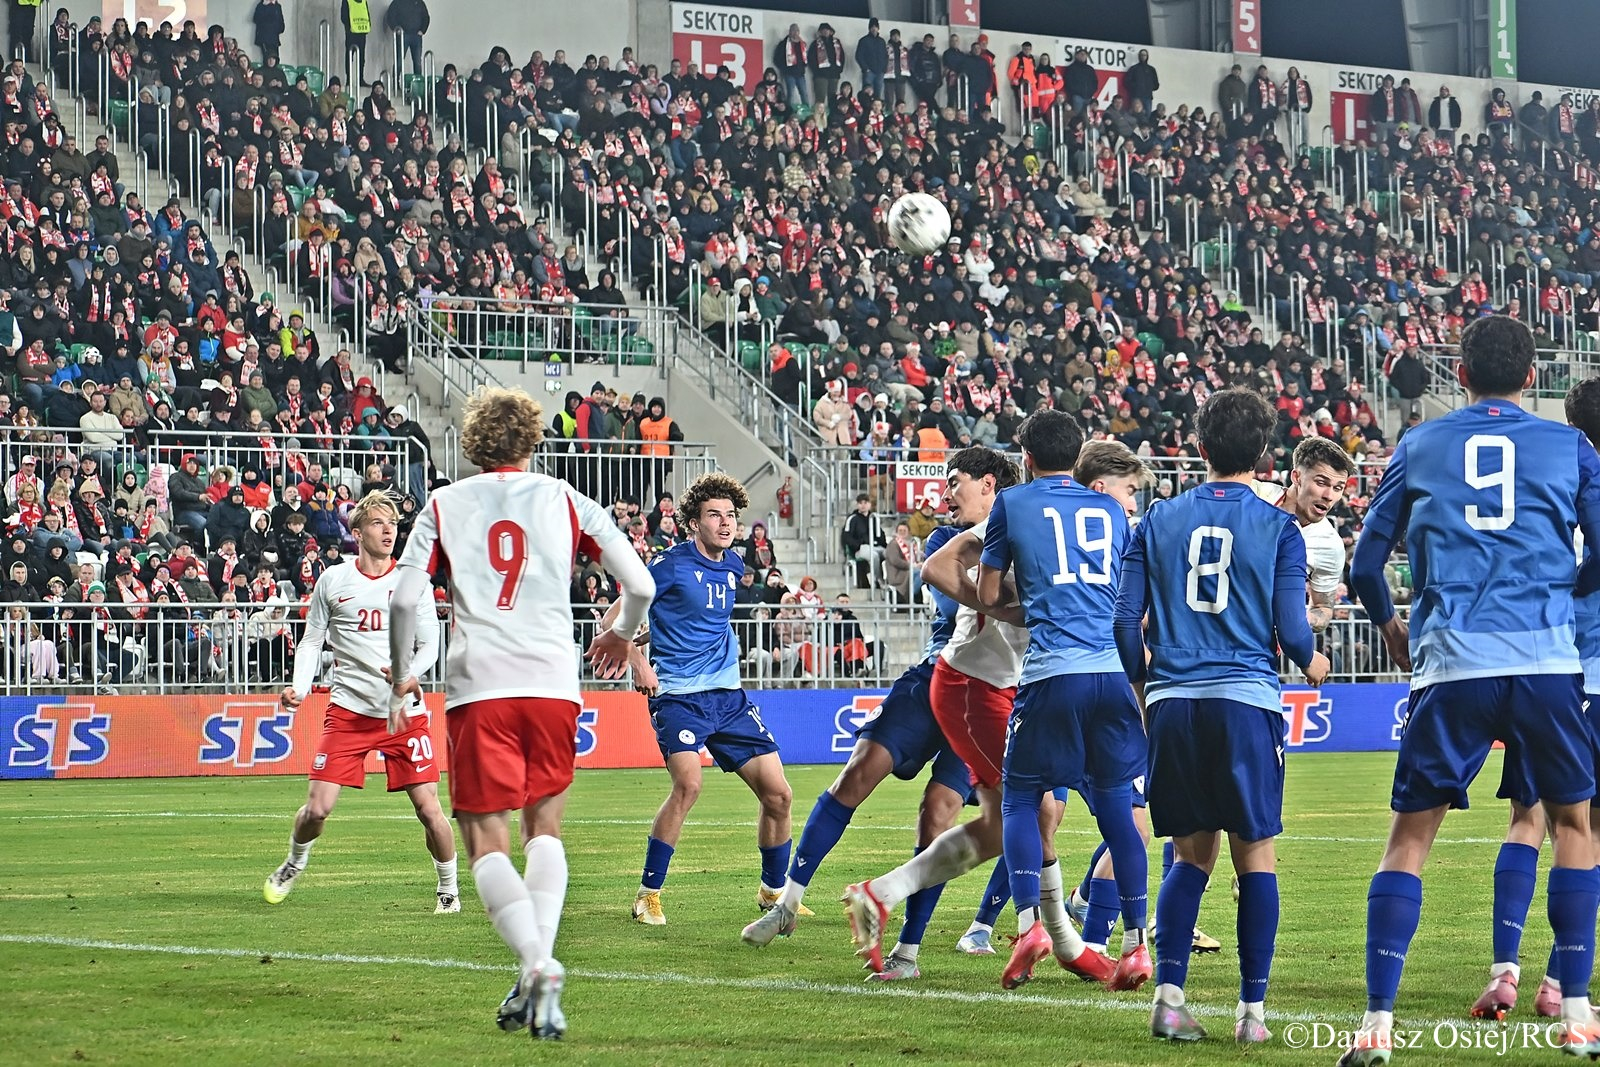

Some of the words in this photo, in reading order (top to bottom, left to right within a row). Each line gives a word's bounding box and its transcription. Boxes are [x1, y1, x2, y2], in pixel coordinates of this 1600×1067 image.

[682, 9, 753, 34] SEKTOR
[902, 464, 945, 477] SEKTOR
[1464, 434, 1516, 531] 9
[487, 519, 529, 611] 9
[1043, 507, 1113, 585] 19
[1186, 525, 1234, 615] 8
[357, 608, 382, 632] 20
[705, 582, 727, 610] 14
[8, 703, 112, 770] STS
[198, 701, 294, 768] STS
[407, 734, 433, 763] 20
